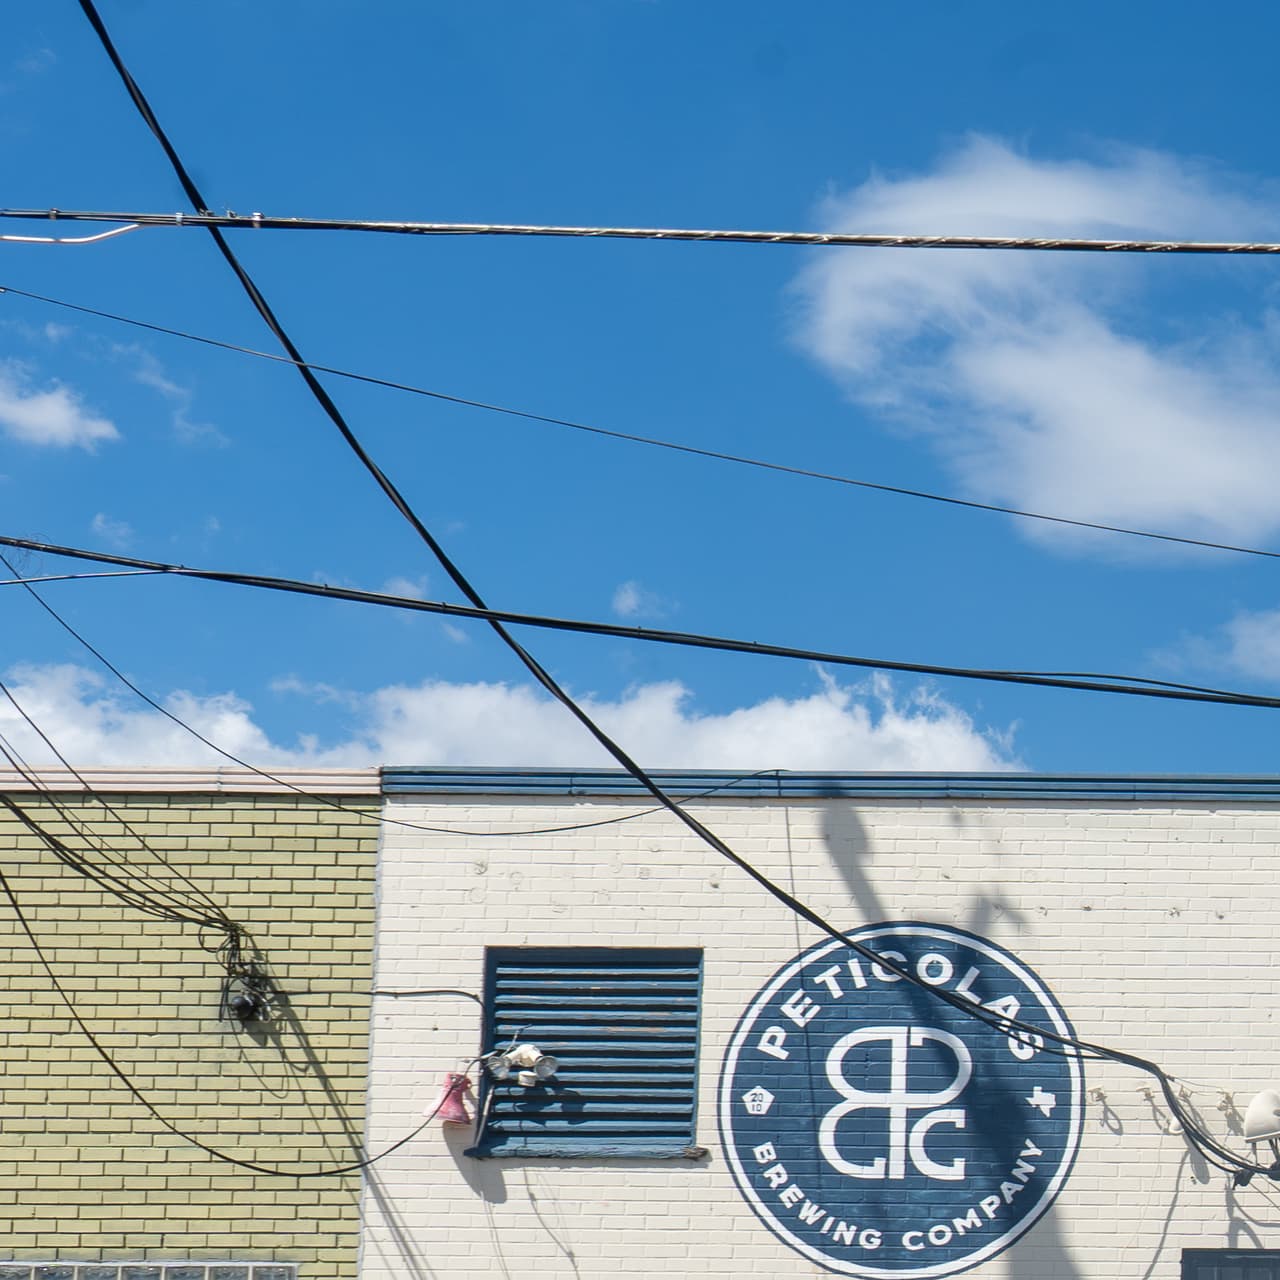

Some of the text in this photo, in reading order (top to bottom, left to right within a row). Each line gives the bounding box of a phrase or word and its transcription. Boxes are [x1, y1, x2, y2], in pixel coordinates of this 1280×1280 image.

[757, 951, 1044, 1060] PETICOLAS
[750, 1092, 764, 1103] 20
[753, 1138, 1044, 1250] BREWING COMPANY
